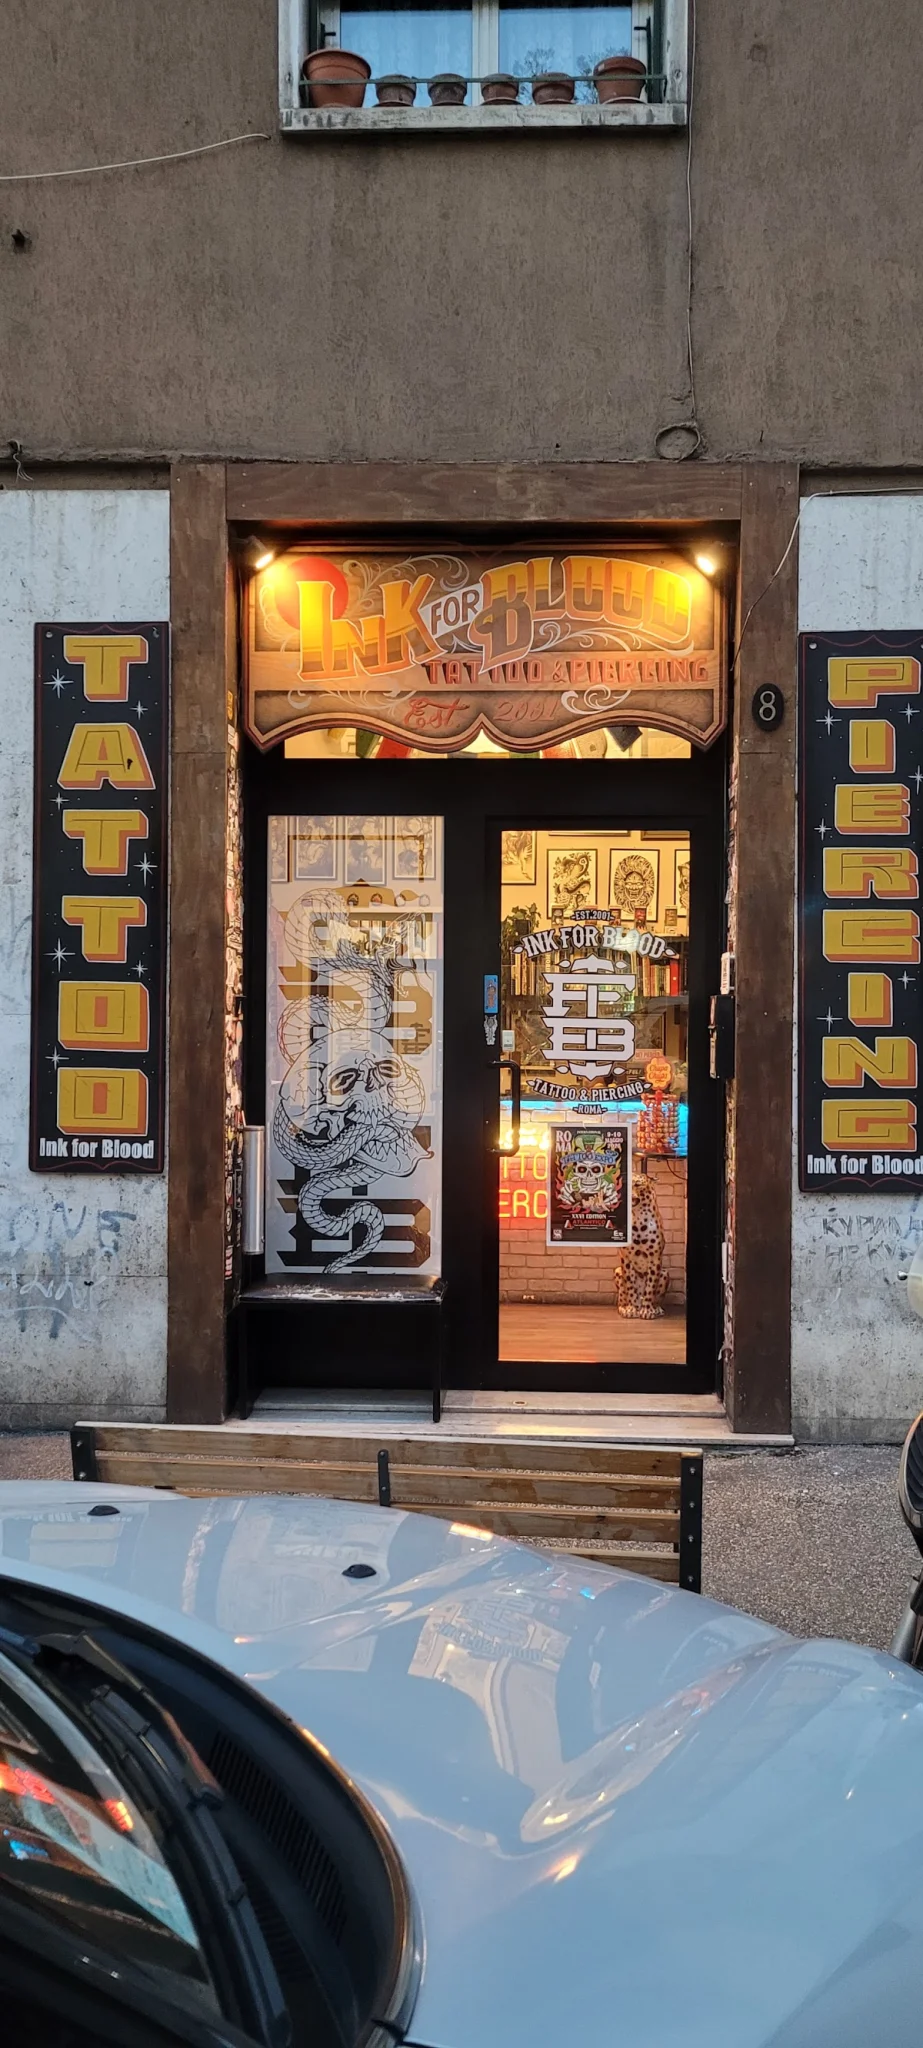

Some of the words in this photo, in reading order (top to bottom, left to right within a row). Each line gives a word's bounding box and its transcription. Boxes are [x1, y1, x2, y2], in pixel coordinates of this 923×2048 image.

[430, 589, 479, 636] FOR
[467, 555, 692, 675] BLOOD
[422, 658, 543, 685] TATTOO
[552, 659, 566, 683] &
[568, 657, 709, 684] PIERCING
[493, 700, 559, 723] 2001
[759, 690, 776, 721] 8
[57, 635, 157, 1137] TATTOO
[823, 656, 922, 1152] PIERCING
[521, 930, 559, 957] INK
[560, 924, 599, 949] FOR
[602, 925, 666, 958] BLOOD
[534, 1079, 575, 1100] TATTOO
[580, 1088, 588, 1100] &
[592, 1081, 643, 1101] PIERCING
[39, 1138, 68, 1157] Ink
[72, 1139, 98, 1158] for
[102, 1139, 154, 1159] Blood
[807, 1154, 837, 1174] Ink
[840, 1155, 868, 1174] for
[871, 1155, 923, 1175] Blood
